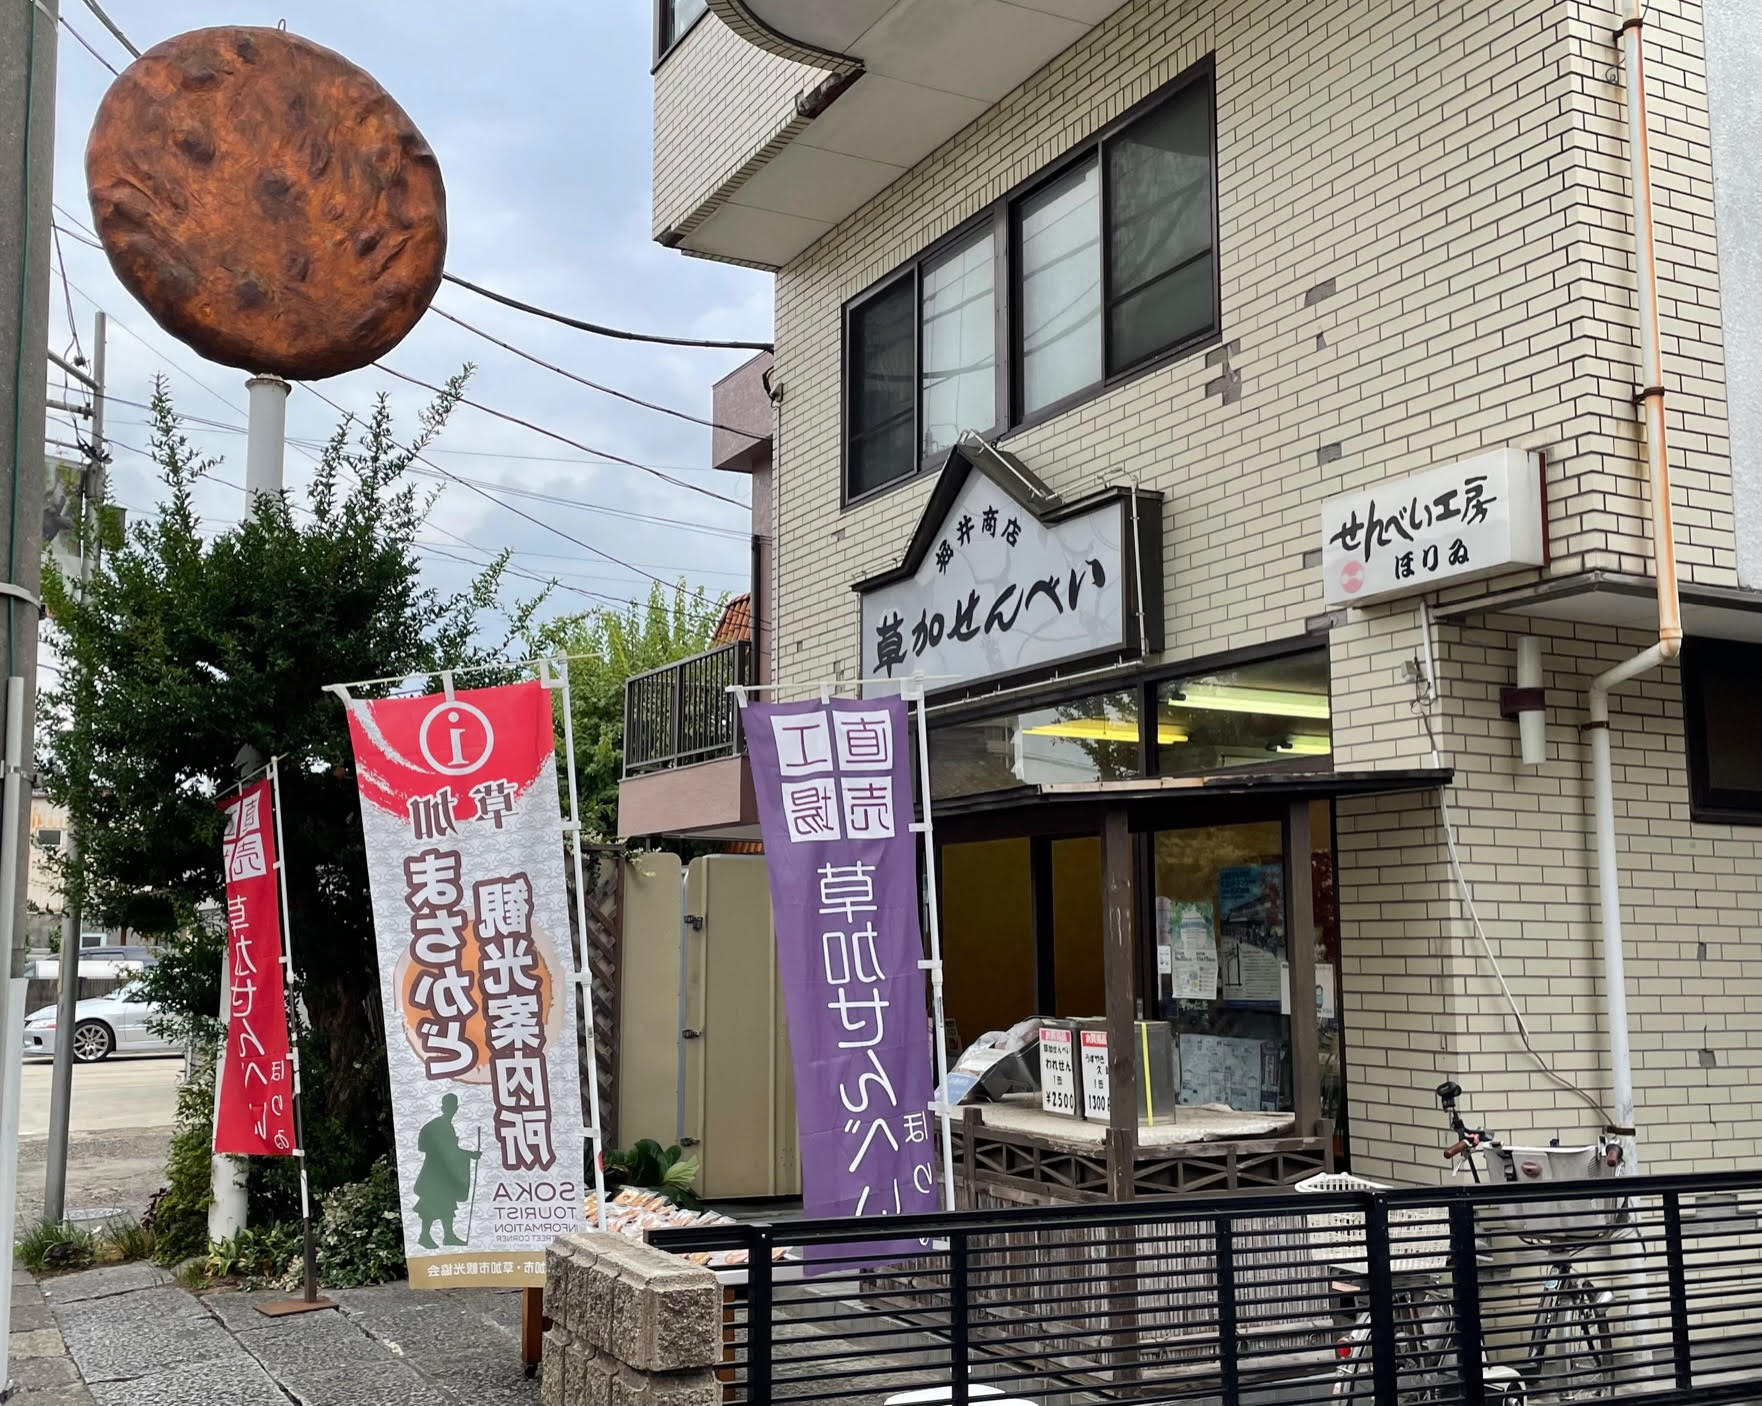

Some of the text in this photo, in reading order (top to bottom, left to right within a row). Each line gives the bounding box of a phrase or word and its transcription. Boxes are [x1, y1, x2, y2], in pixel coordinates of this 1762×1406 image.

[1330, 475, 1497, 563] せんべい工房
[1394, 538, 1470, 580] ほりゐ
[872, 557, 1106, 679] 草加せんべい
